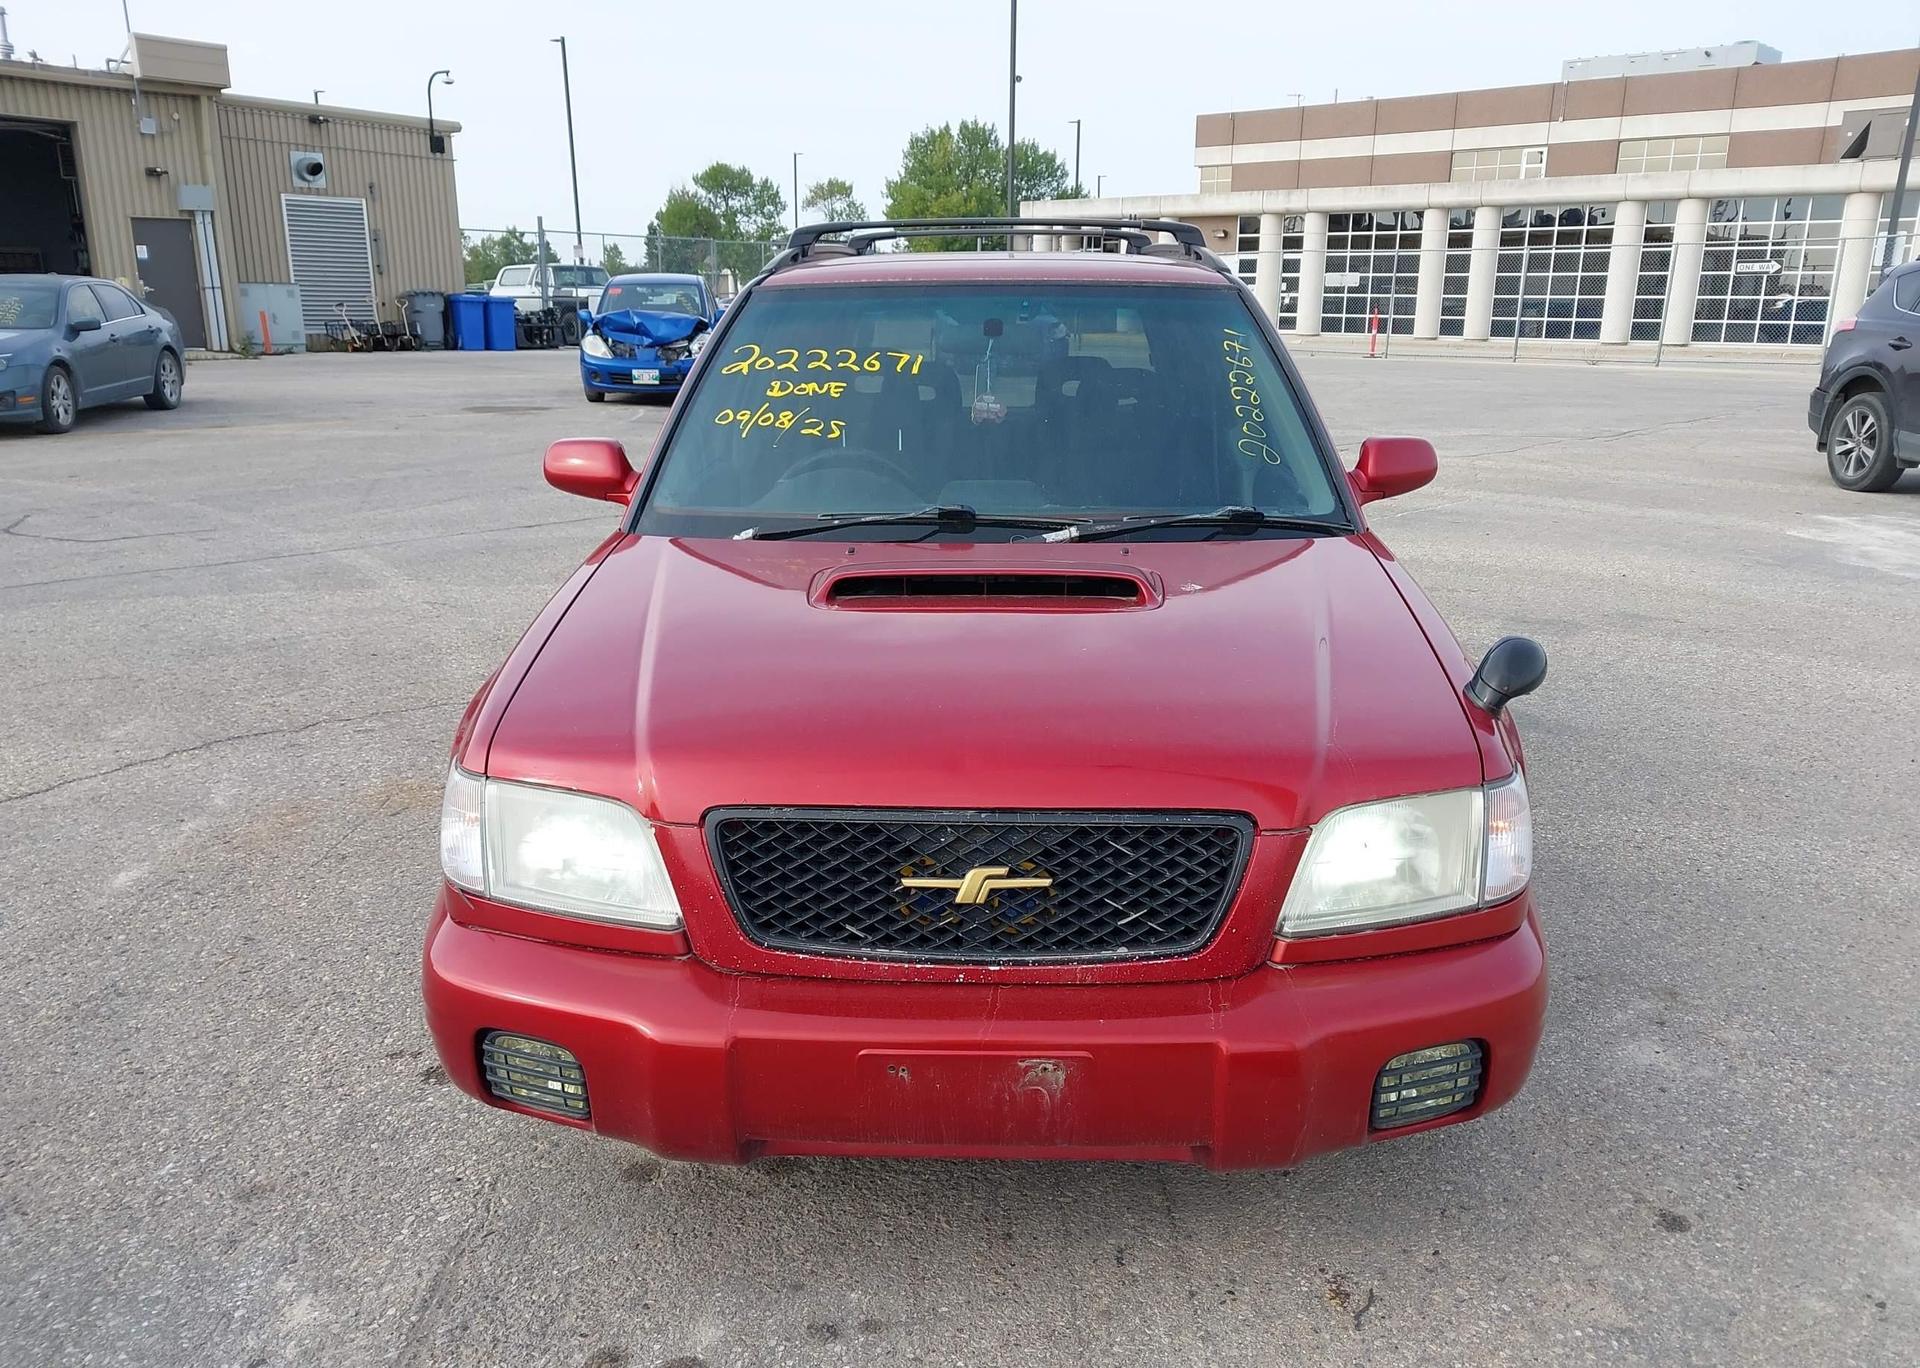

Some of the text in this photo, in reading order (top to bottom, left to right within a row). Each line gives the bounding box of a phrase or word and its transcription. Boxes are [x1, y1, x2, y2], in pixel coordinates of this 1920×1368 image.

[721, 344, 924, 375] 20222671
[766, 380, 847, 397] DONE
[1223, 328, 1281, 465] 20222671
[714, 402, 846, 448] 09/08/25
